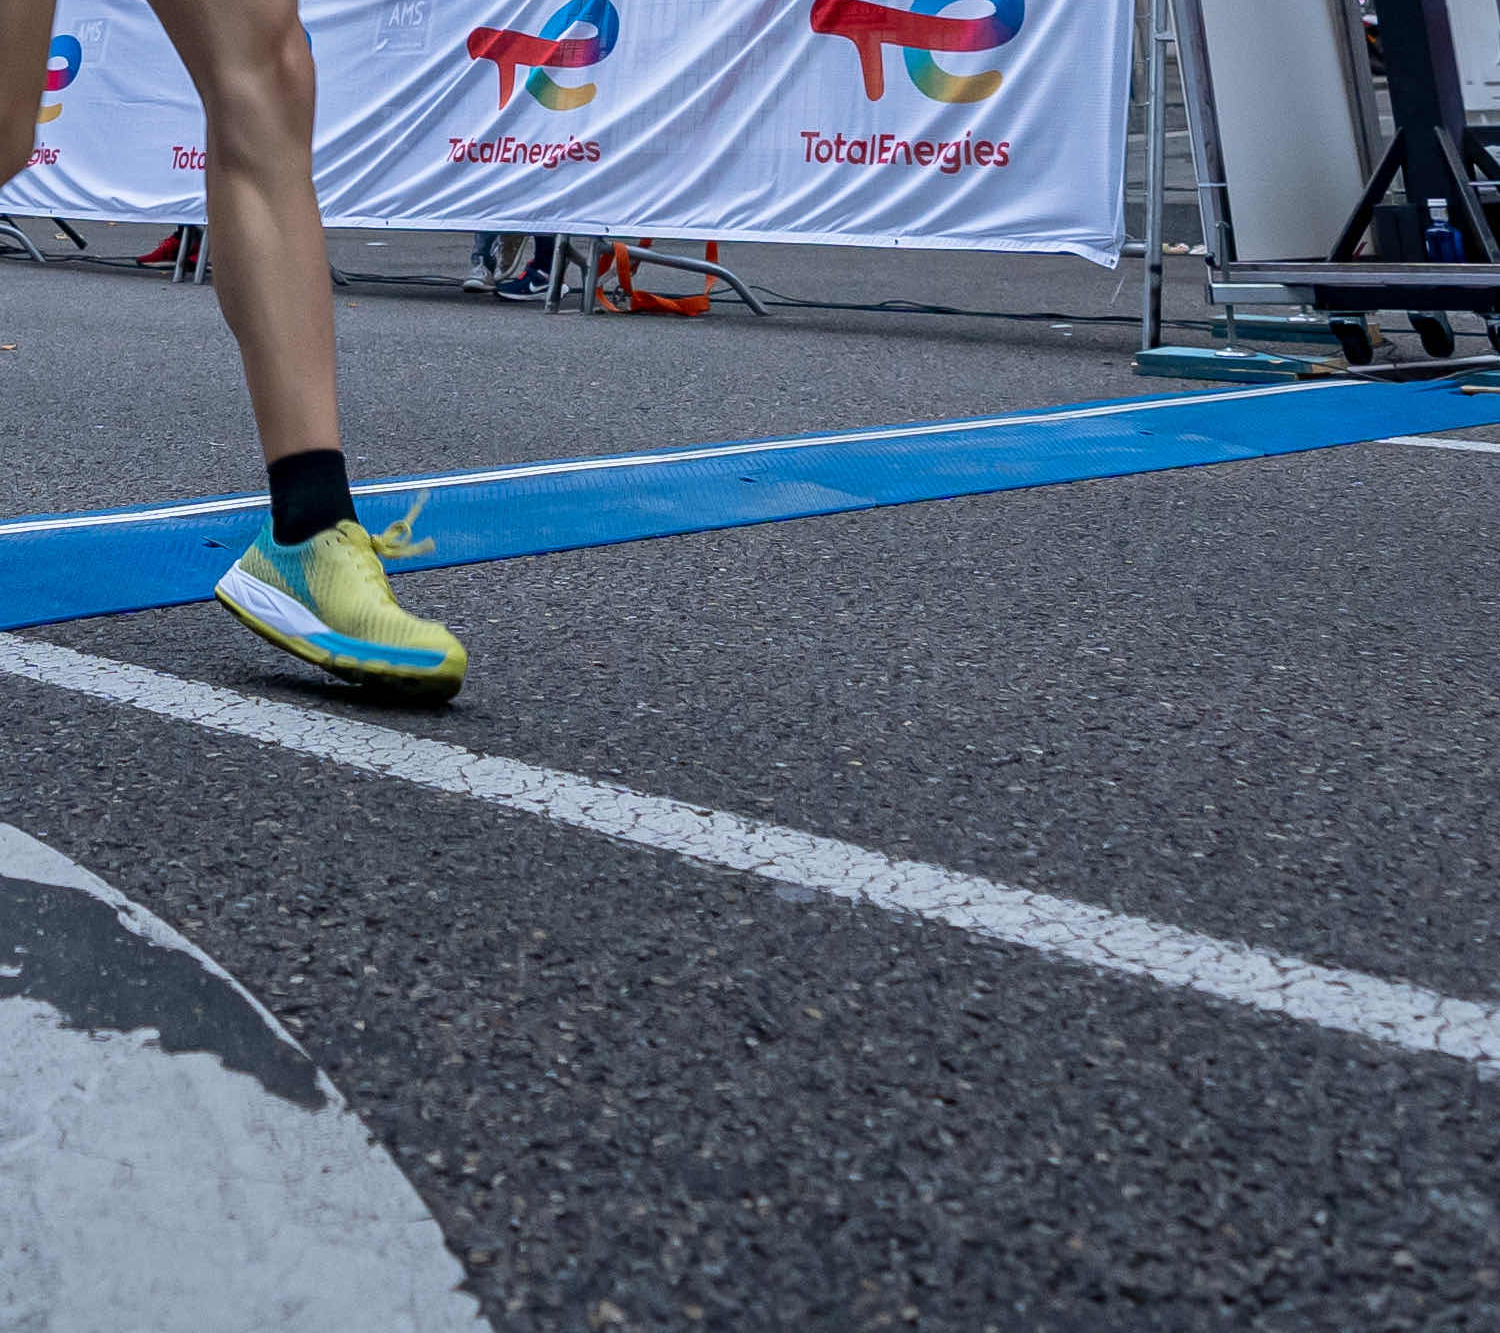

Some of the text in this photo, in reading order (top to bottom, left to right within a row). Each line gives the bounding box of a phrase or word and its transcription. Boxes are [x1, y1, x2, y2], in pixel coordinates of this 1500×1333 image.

[388, 0, 425, 26] AMS
[447, 135, 600, 170] TotalEnergies
[801, 130, 1010, 175] TotalEnergies
